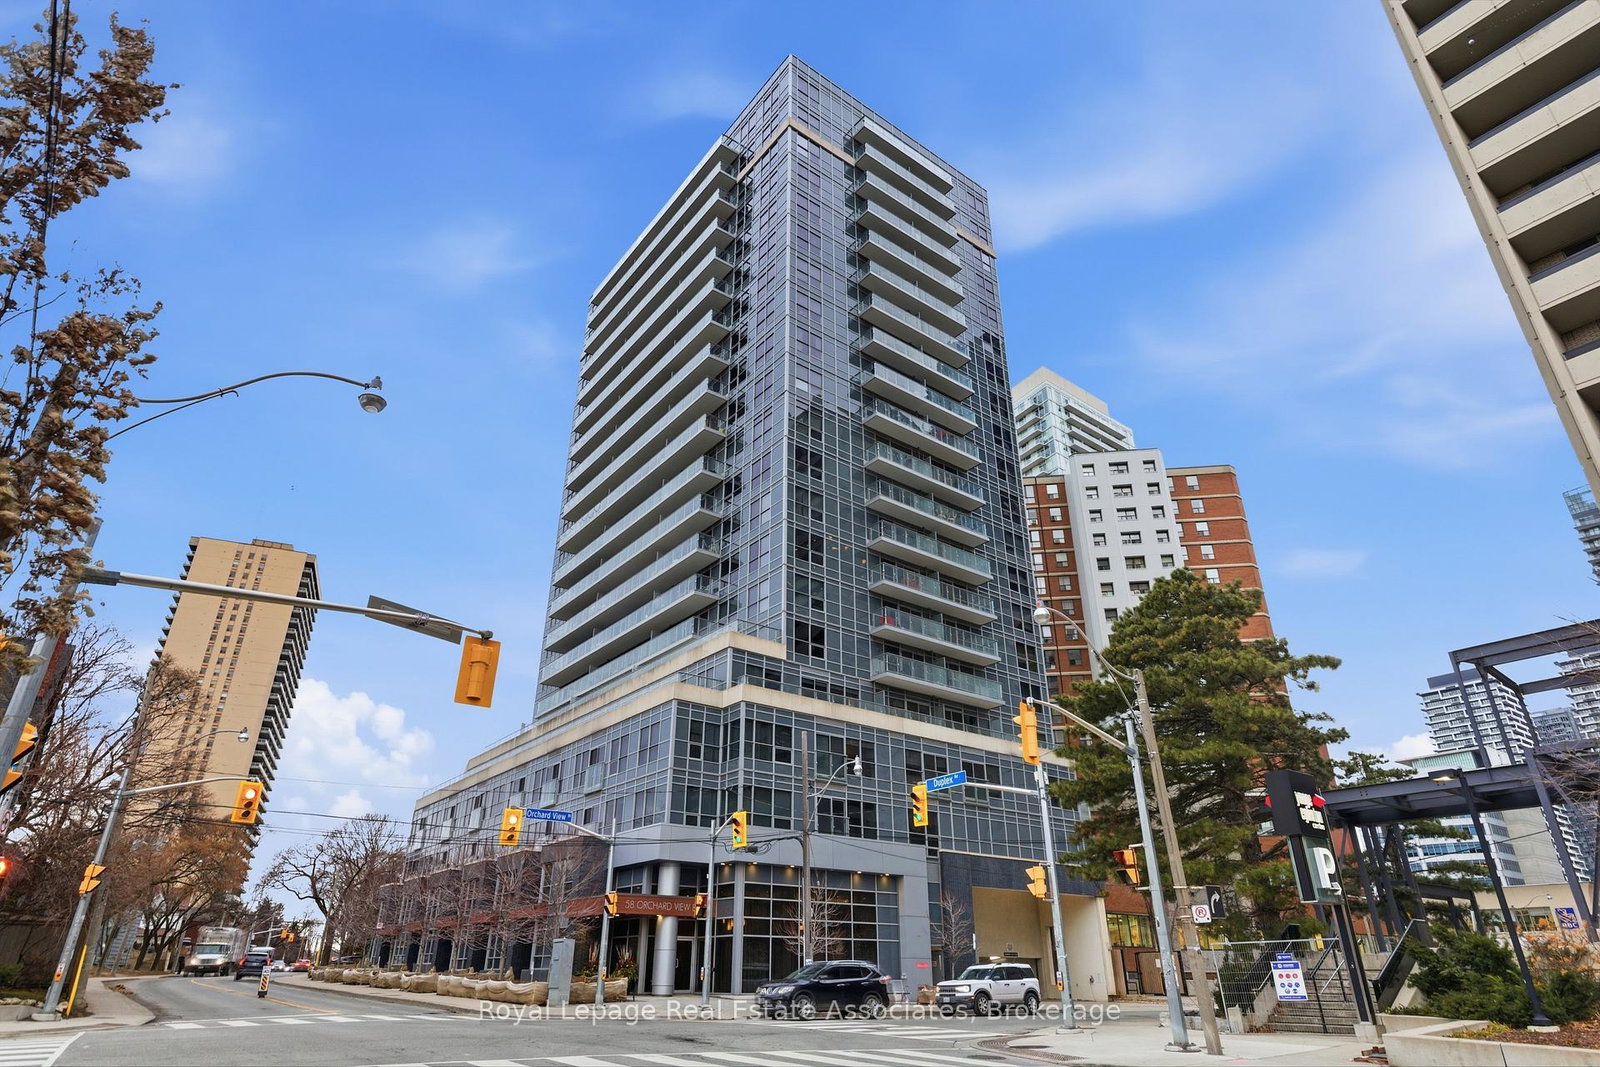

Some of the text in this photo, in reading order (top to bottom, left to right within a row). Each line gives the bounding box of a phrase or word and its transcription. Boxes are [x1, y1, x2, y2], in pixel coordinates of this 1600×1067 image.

[933, 777, 954, 788] Duplex
[526, 808, 552, 820] Orchard
[552, 811, 567, 821] View
[624, 900, 635, 910] 58
[636, 900, 673, 912] ORCHARD
[674, 902, 690, 912] VIEW
